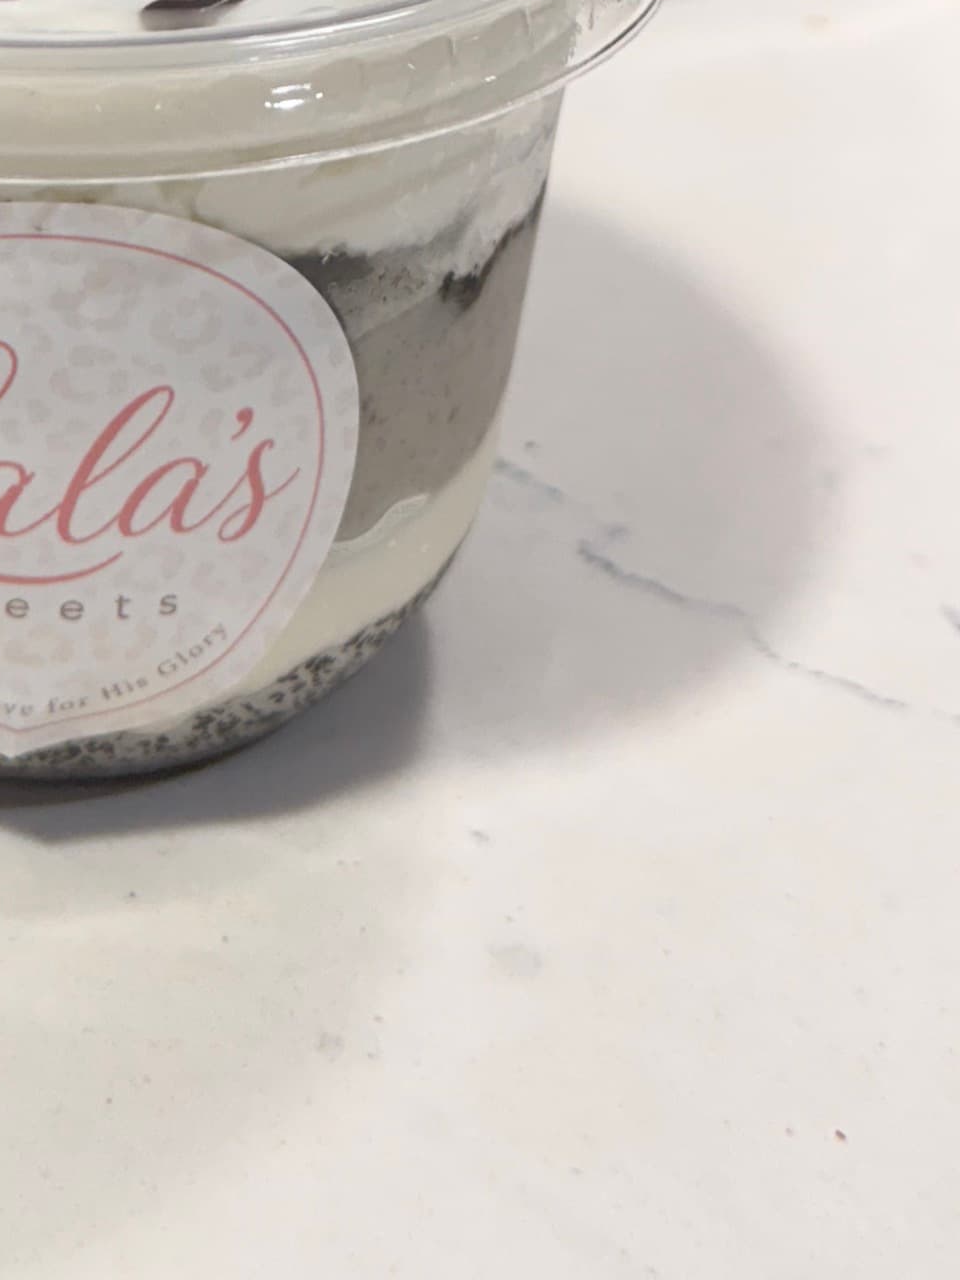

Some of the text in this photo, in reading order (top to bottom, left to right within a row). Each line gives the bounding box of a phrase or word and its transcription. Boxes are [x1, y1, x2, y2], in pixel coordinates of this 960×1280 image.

[46, 693, 90, 715] for
[102, 677, 149, 702] His
[156, 621, 231, 679] Glory
